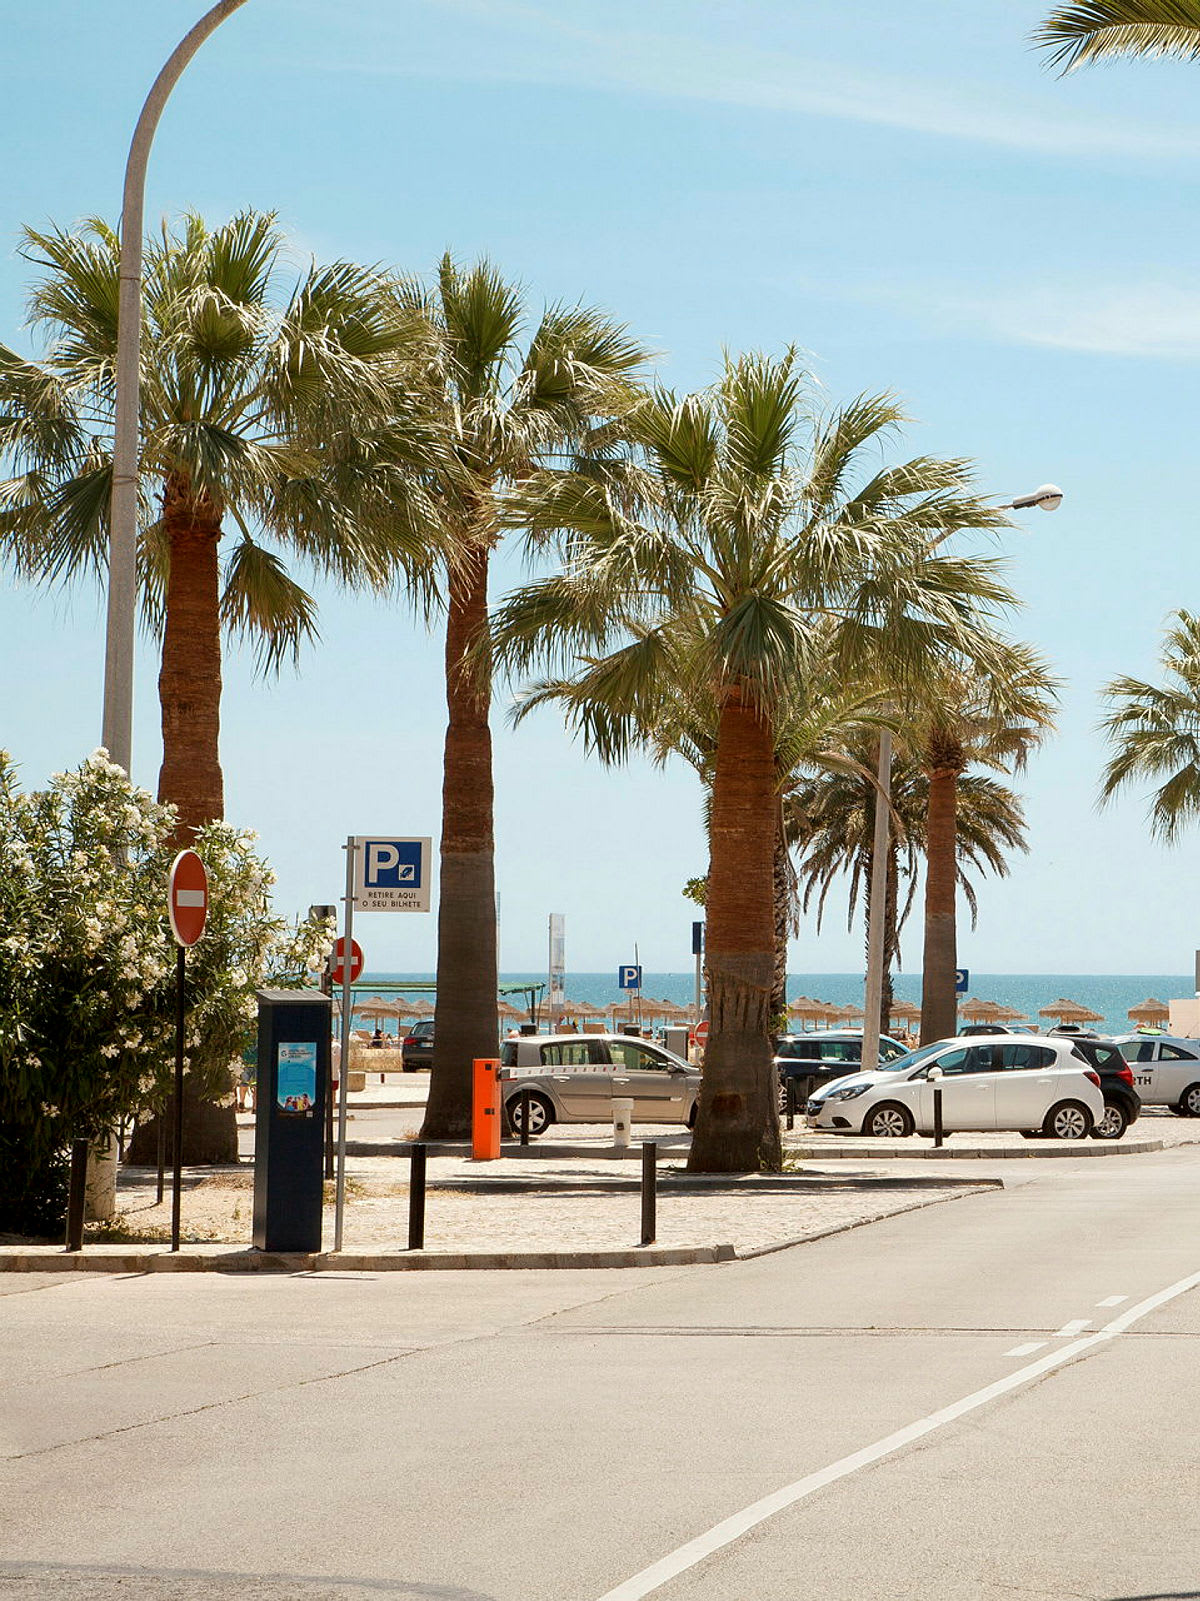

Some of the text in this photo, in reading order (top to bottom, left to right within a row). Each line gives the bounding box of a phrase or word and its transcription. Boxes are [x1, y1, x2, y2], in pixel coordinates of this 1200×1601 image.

[368, 844, 400, 883] P
[368, 891, 416, 899] RETIRE AQUI
[391, 900, 421, 908] BILHETE
[623, 967, 638, 987] P
